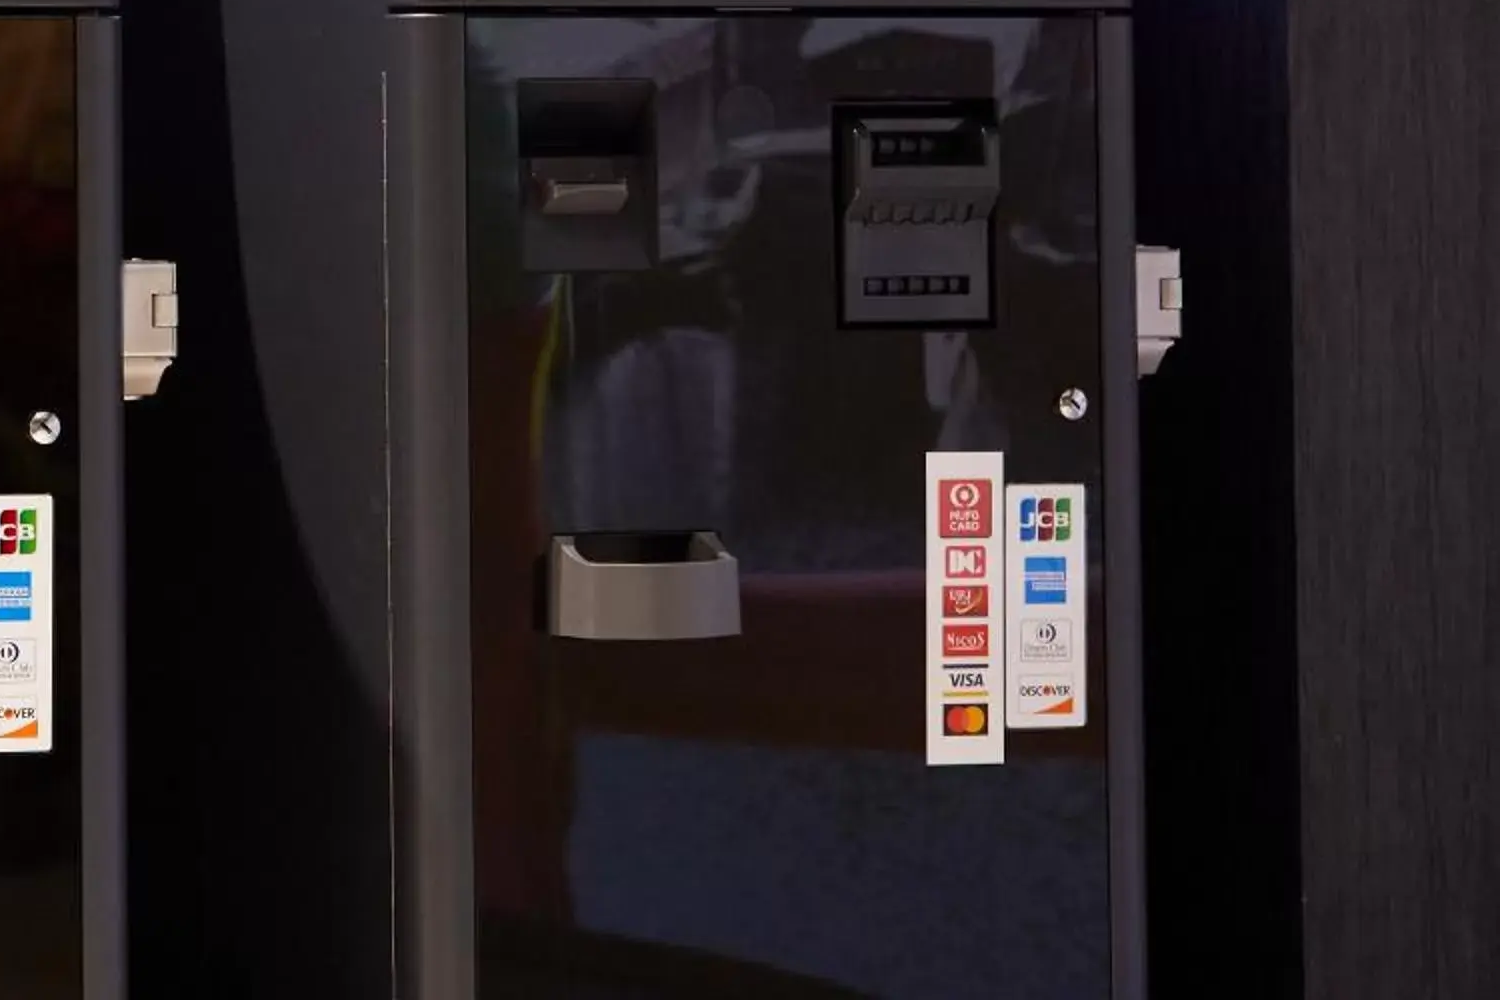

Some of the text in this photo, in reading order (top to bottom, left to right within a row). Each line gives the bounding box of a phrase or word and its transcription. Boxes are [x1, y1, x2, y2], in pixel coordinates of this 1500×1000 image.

[949, 521, 980, 532] CARD
[950, 673, 985, 687] VISA
[1019, 684, 1071, 697] DISCOVER
